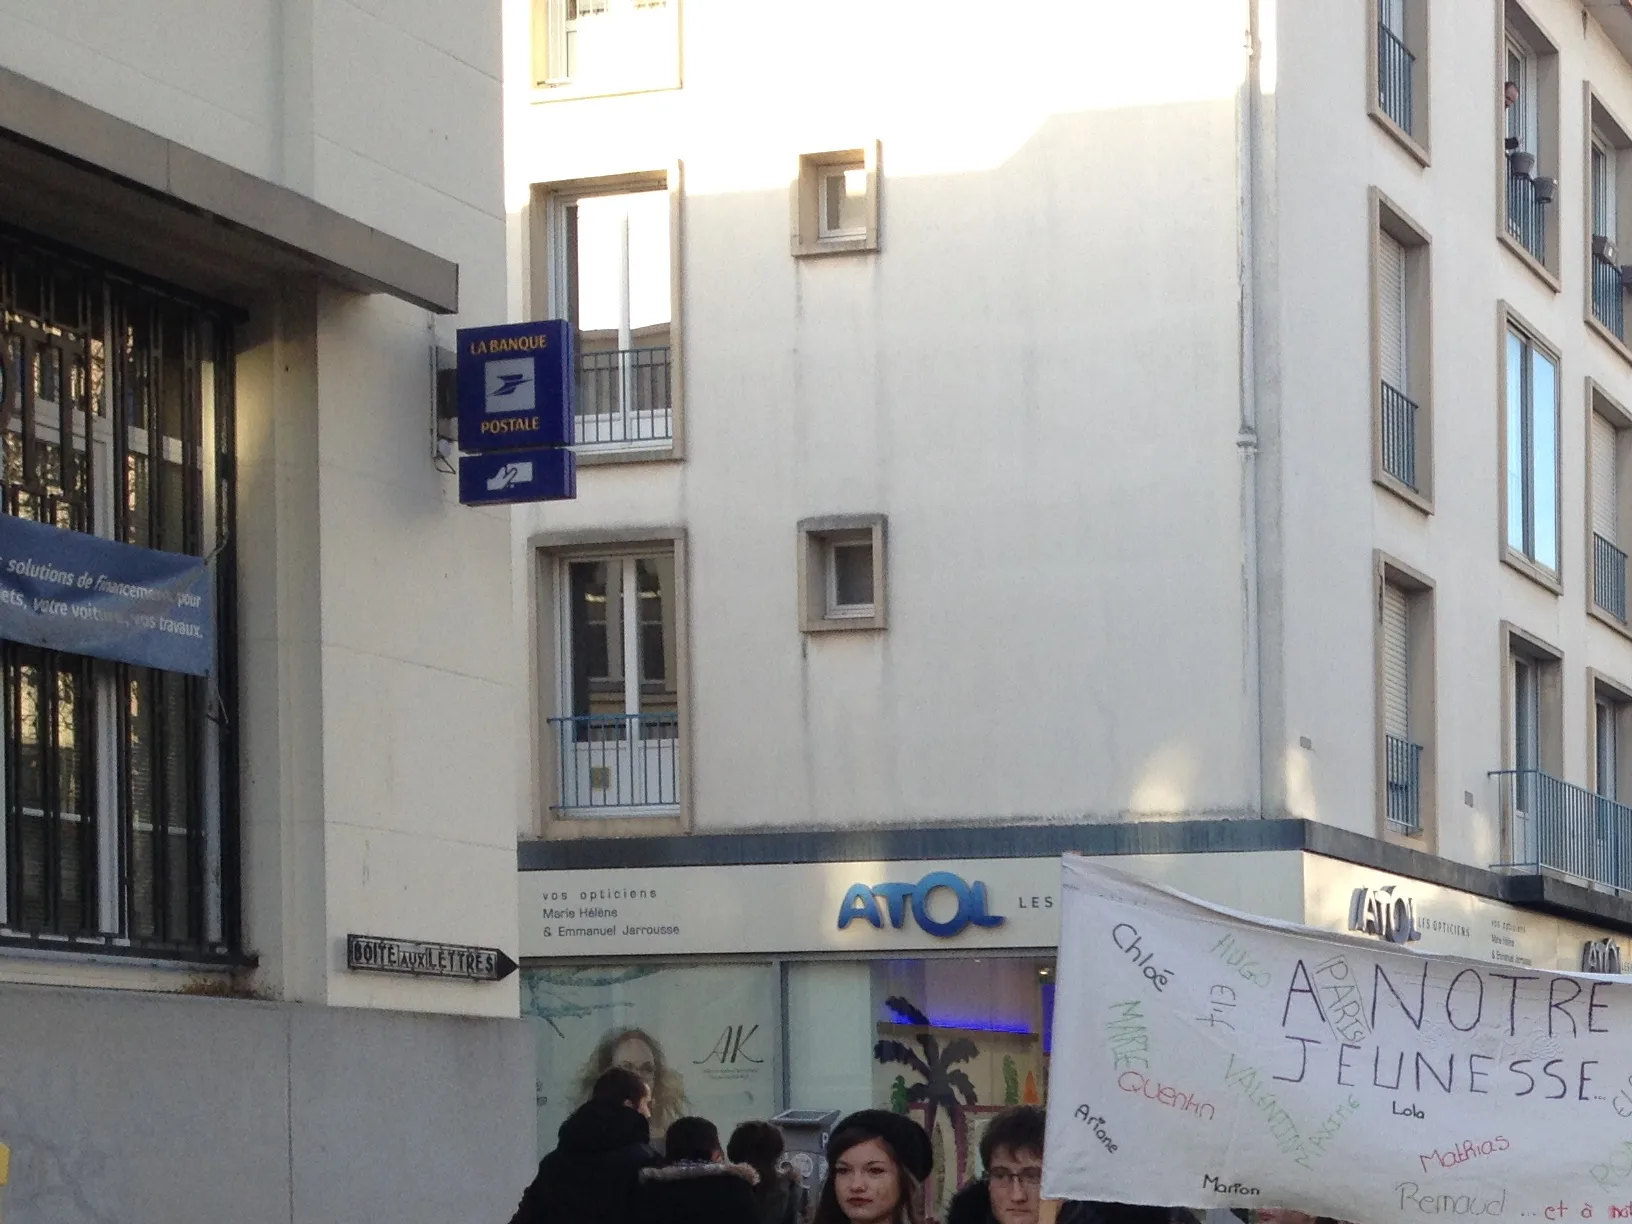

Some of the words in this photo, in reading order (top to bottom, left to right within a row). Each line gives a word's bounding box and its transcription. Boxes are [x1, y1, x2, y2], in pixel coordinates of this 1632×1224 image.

[471, 341, 487, 354] LA
[490, 335, 547, 352] BANQUE
[480, 417, 540, 434] POSTALE
[7, 558, 73, 586] solutions
[77, 572, 94, 590] de
[177, 592, 201, 608] pour
[0, 587, 28, 611] ets,
[34, 597, 68, 616] votre
[134, 613, 156, 628] vos
[160, 616, 203, 638] travaux.
[543, 892, 567, 900] vos
[580, 889, 657, 902] opticiens
[543, 908, 575, 918] Marie
[837, 871, 1006, 937] ATOL
[1018, 896, 1053, 908] LES
[1348, 885, 1421, 944] ATOL
[1418, 917, 1430, 930] LES
[1432, 920, 1470, 938] OPTICIENS
[543, 927, 552, 937] &
[558, 925, 616, 937] Emmanuel
[622, 925, 680, 936] Jarrousse
[354, 942, 397, 964] BOITE
[401, 952, 426, 968] AUX
[427, 948, 494, 972] LETTRES
[1112, 923, 1174, 992] Chloé
[1209, 932, 1271, 988] HUGO
[1282, 959, 1325, 1028] A
[1371, 961, 1613, 1038] NOTRE
[1316, 960, 1365, 1043] PARIS
[1106, 1000, 1149, 1070] MARIE
[1075, 1104, 1118, 1154] Ariane
[1392, 1101, 1425, 1119] Lola
[1419, 1136, 1510, 1173] Mathias
[1202, 1174, 1260, 1196] Marion
[1581, 1202, 1593, 1219] à
